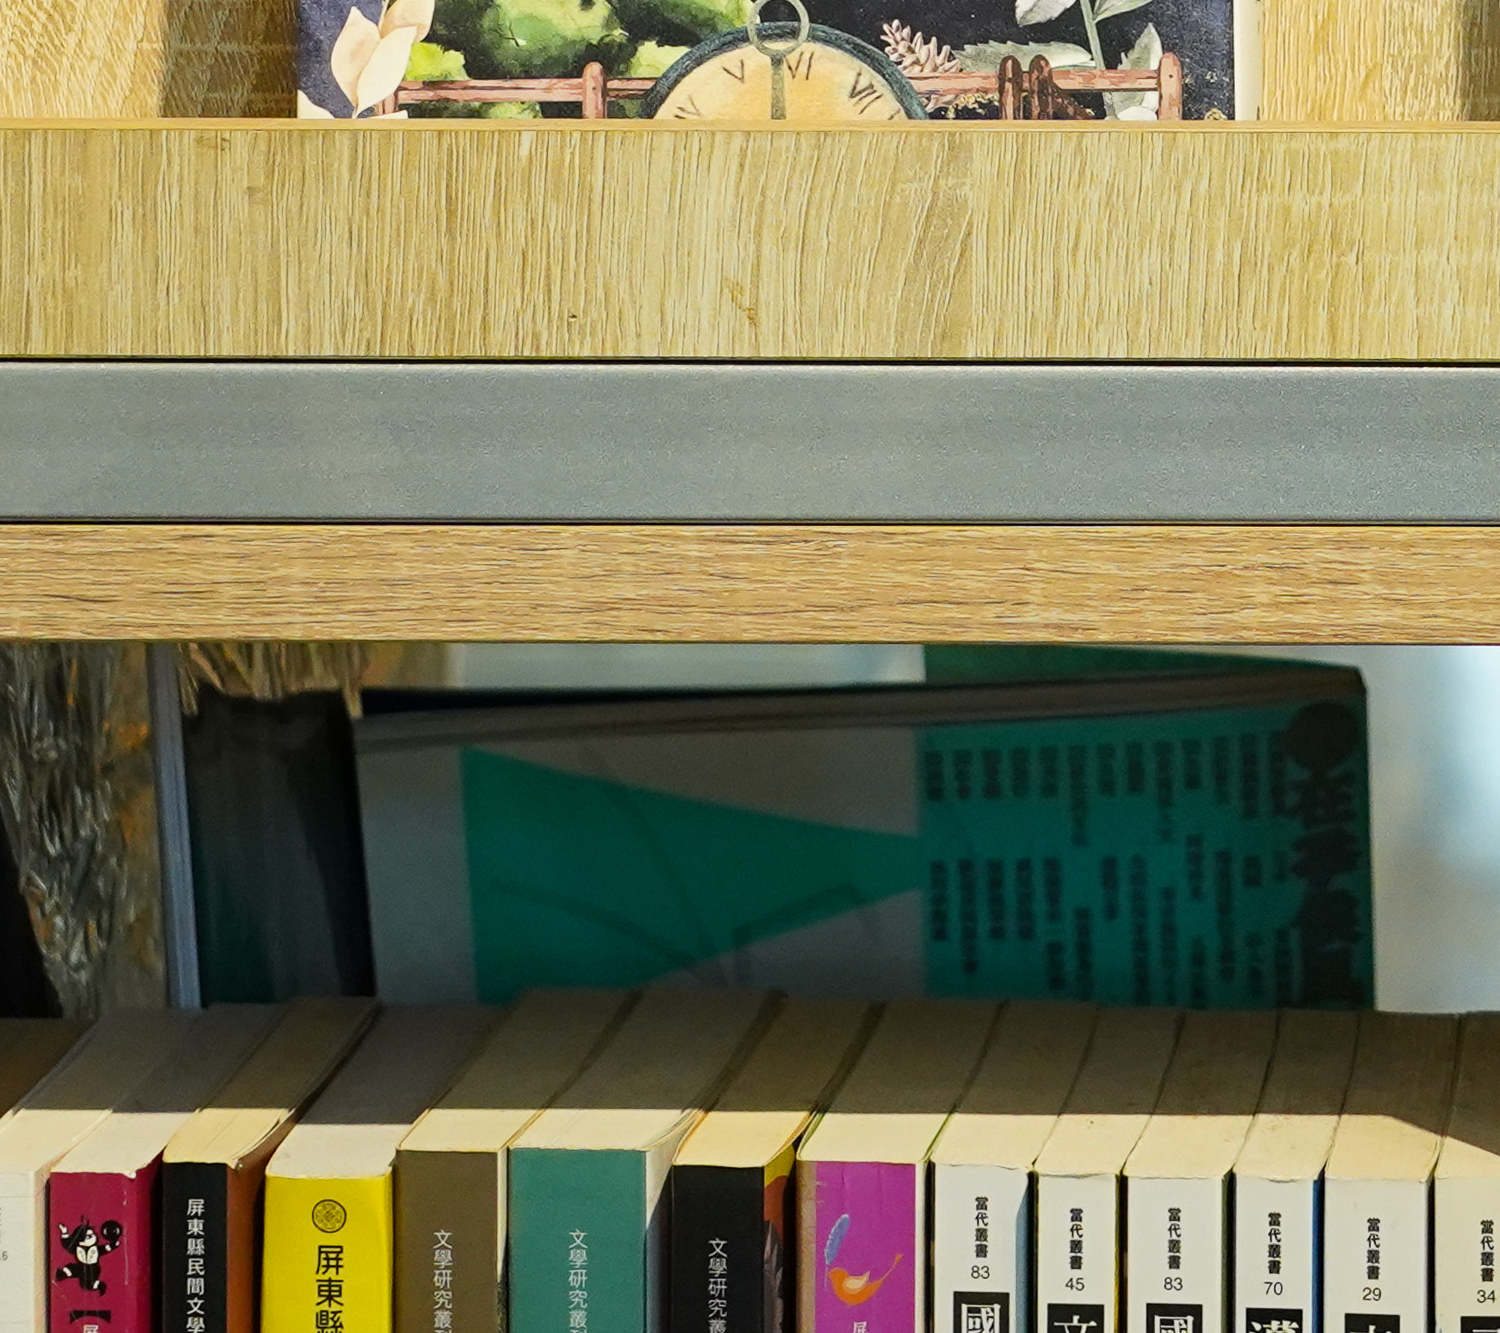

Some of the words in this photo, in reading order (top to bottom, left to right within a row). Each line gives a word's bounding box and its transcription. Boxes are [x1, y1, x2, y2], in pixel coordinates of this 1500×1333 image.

[186, 1199, 206, 1333] 屏東縣民間文學
[970, 1265, 990, 1279] 83
[433, 1229, 453, 1333] 文學研究叢
[567, 1229, 588, 1333] 文學研究叢
[1065, 1277, 1085, 1291] 45
[1164, 1277, 1183, 1291] 83
[315, 1245, 345, 1333] 屏東縣
[1263, 1282, 1283, 1295] 70
[1362, 1287, 1382, 1301] 29
[1476, 1289, 1497, 1303] 34
